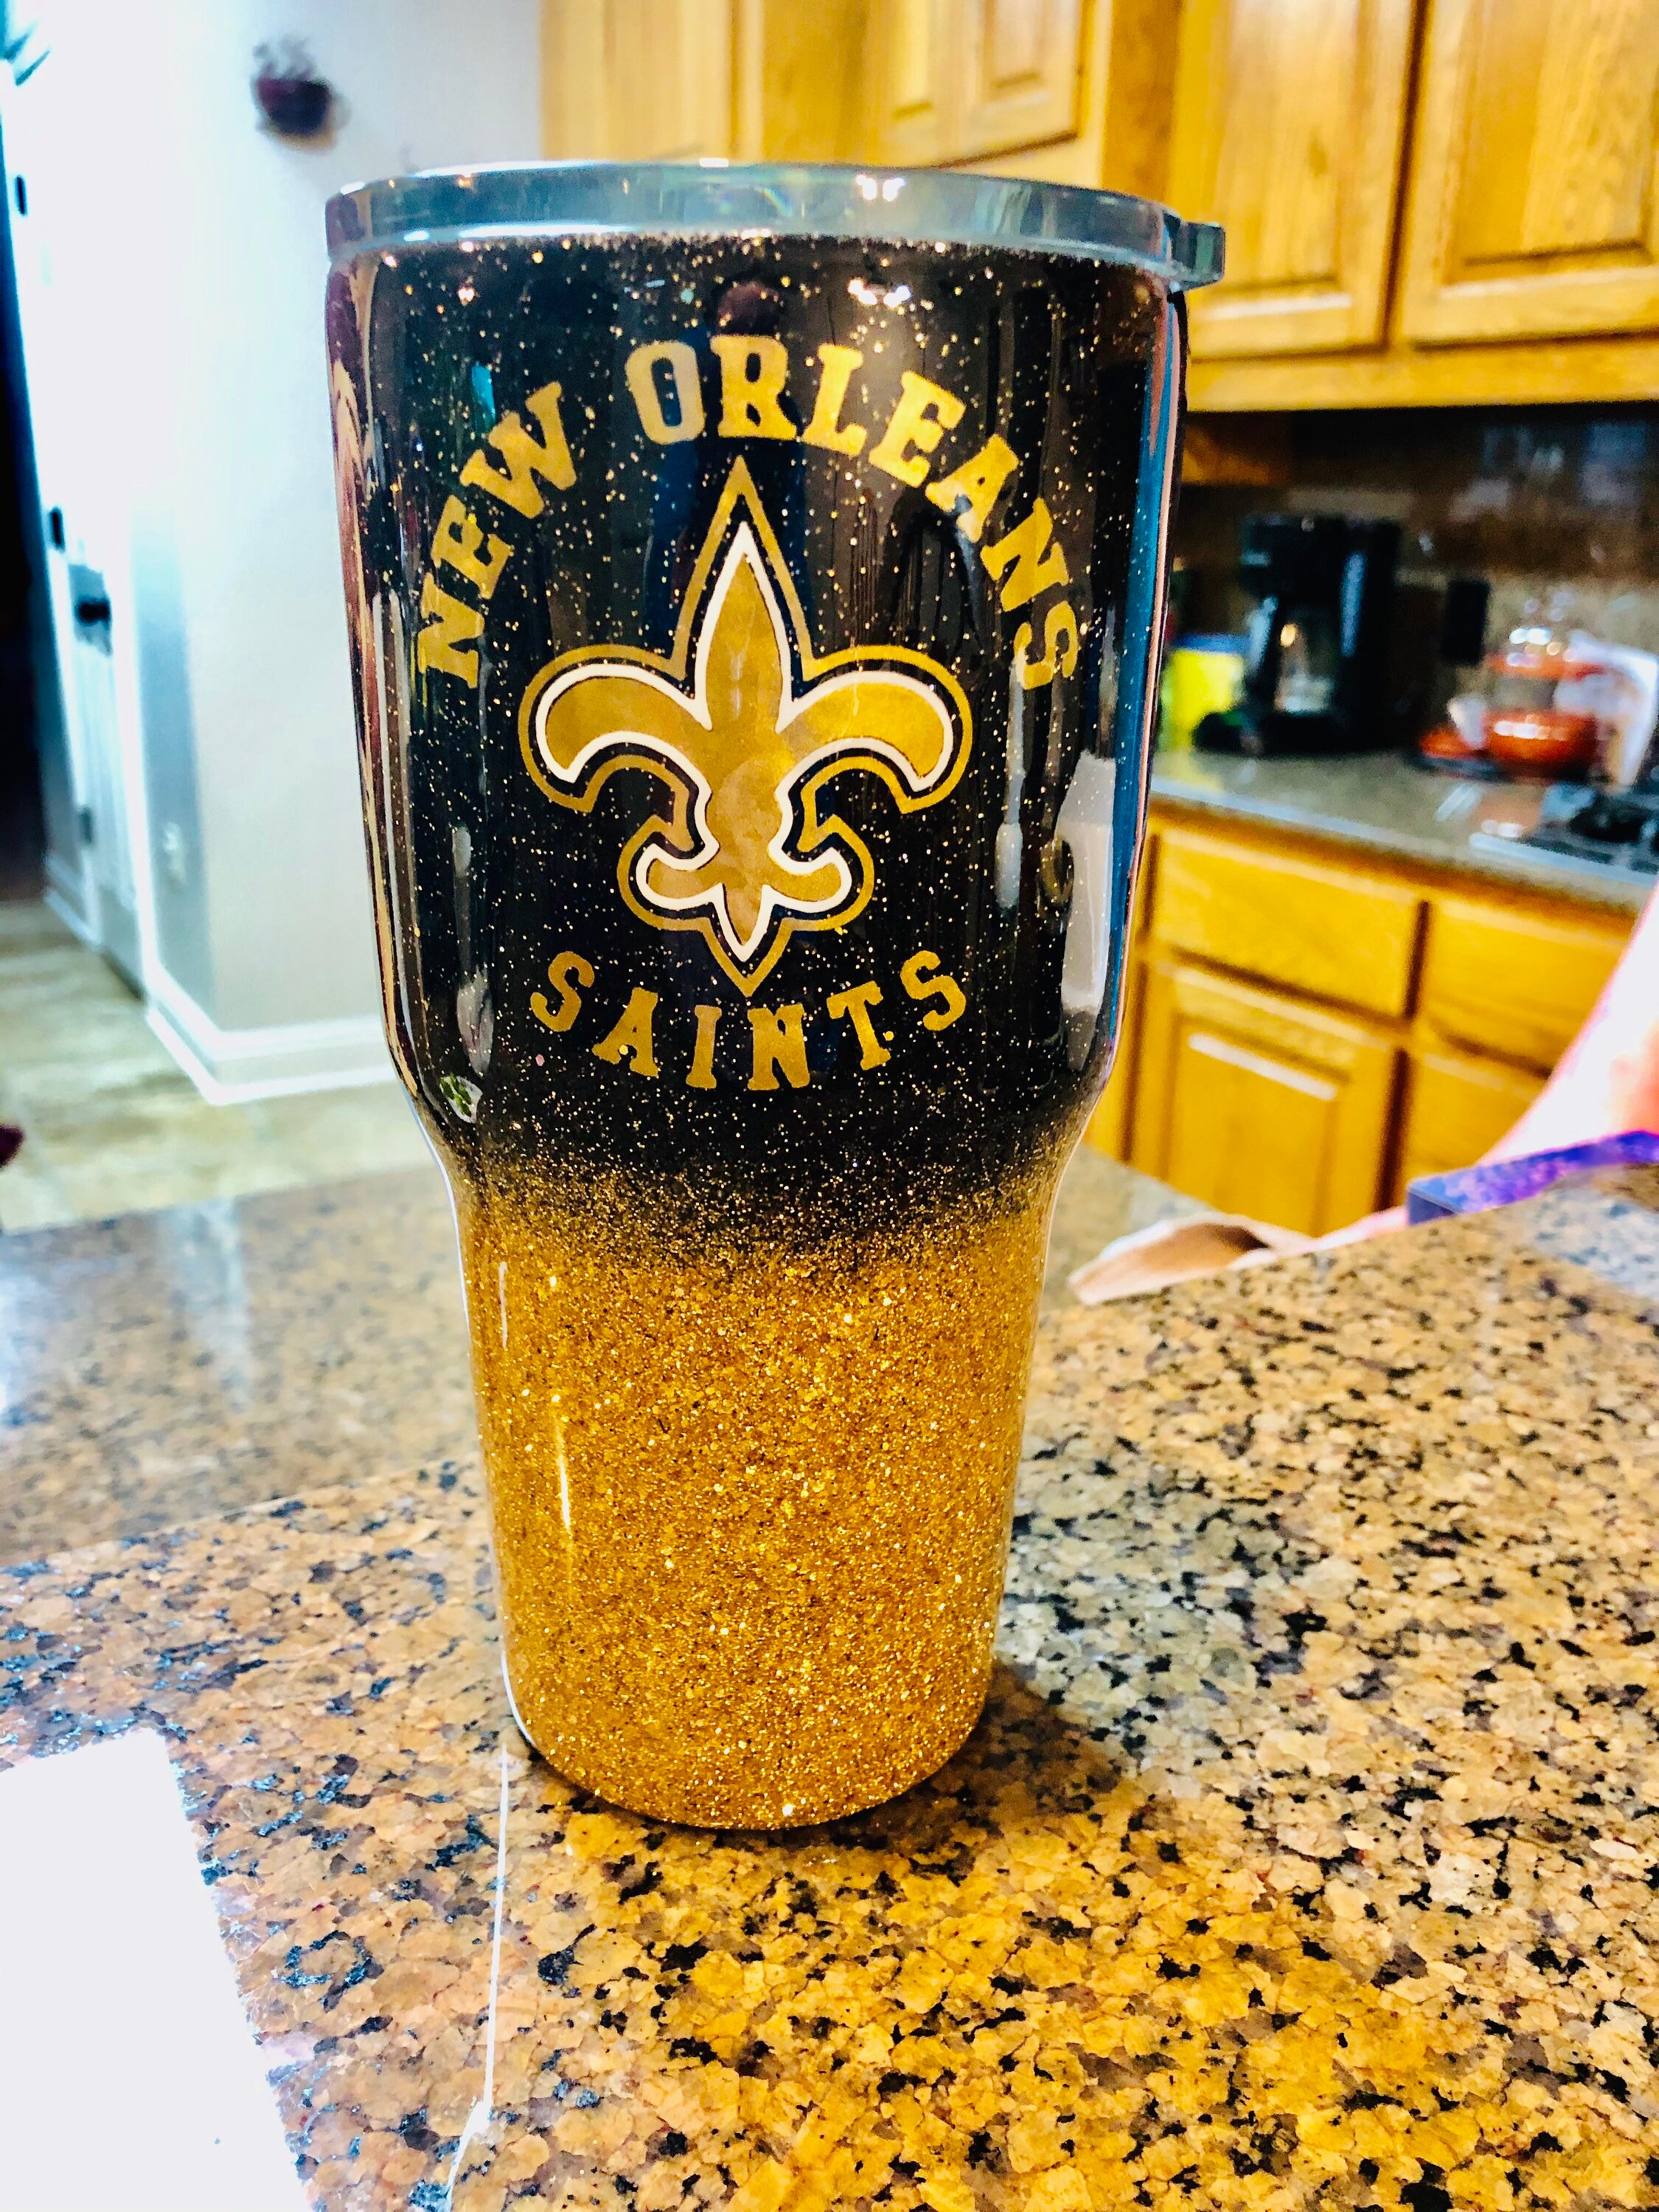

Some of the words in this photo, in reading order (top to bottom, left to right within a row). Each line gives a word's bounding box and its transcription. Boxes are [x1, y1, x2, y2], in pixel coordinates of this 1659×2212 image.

[418, 380, 577, 689] NEW
[624, 334, 1079, 691] ORLEANS
[530, 950, 967, 1091] SAINTS
